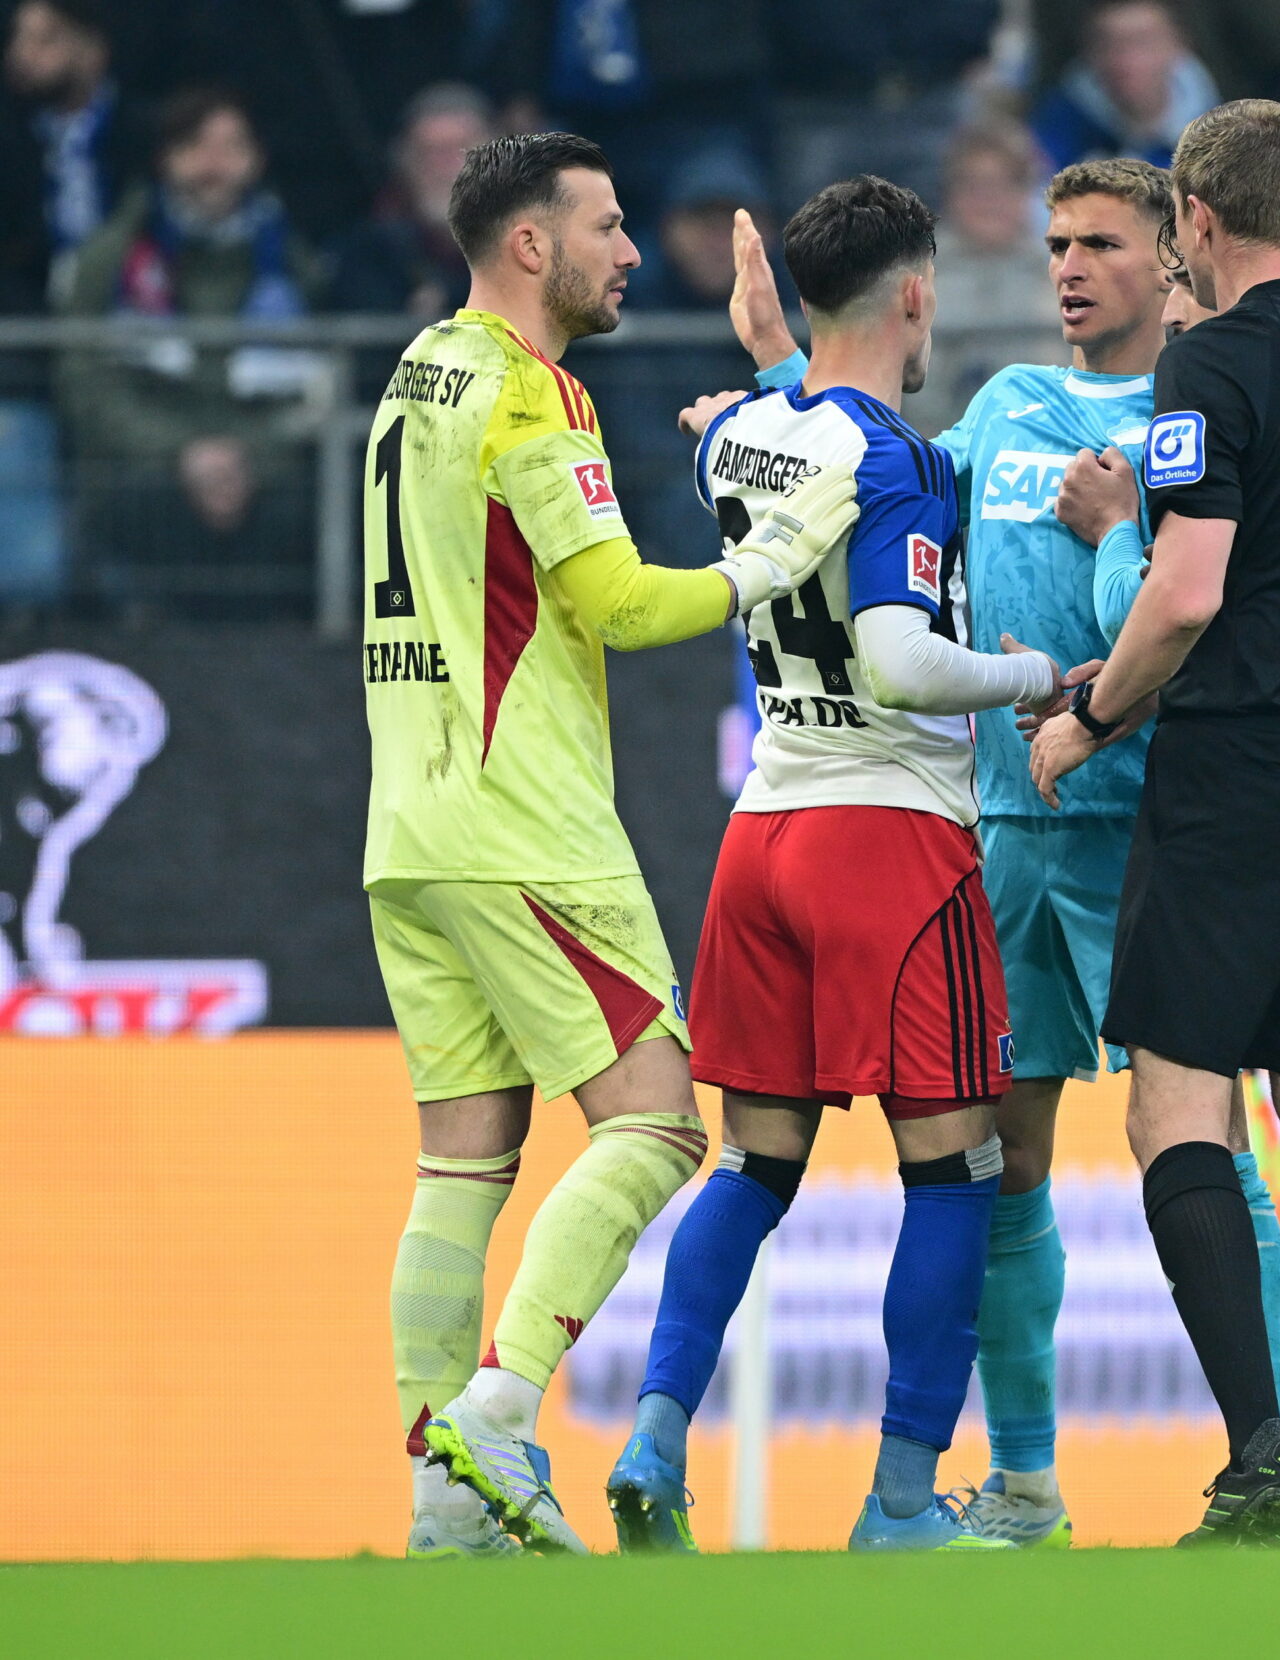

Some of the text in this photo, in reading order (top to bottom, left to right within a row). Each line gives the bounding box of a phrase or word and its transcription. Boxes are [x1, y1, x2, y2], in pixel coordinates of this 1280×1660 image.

[439, 368, 475, 408] SV
[1151, 469, 1197, 483] Das Örtliche
[375, 414, 416, 618] 1
